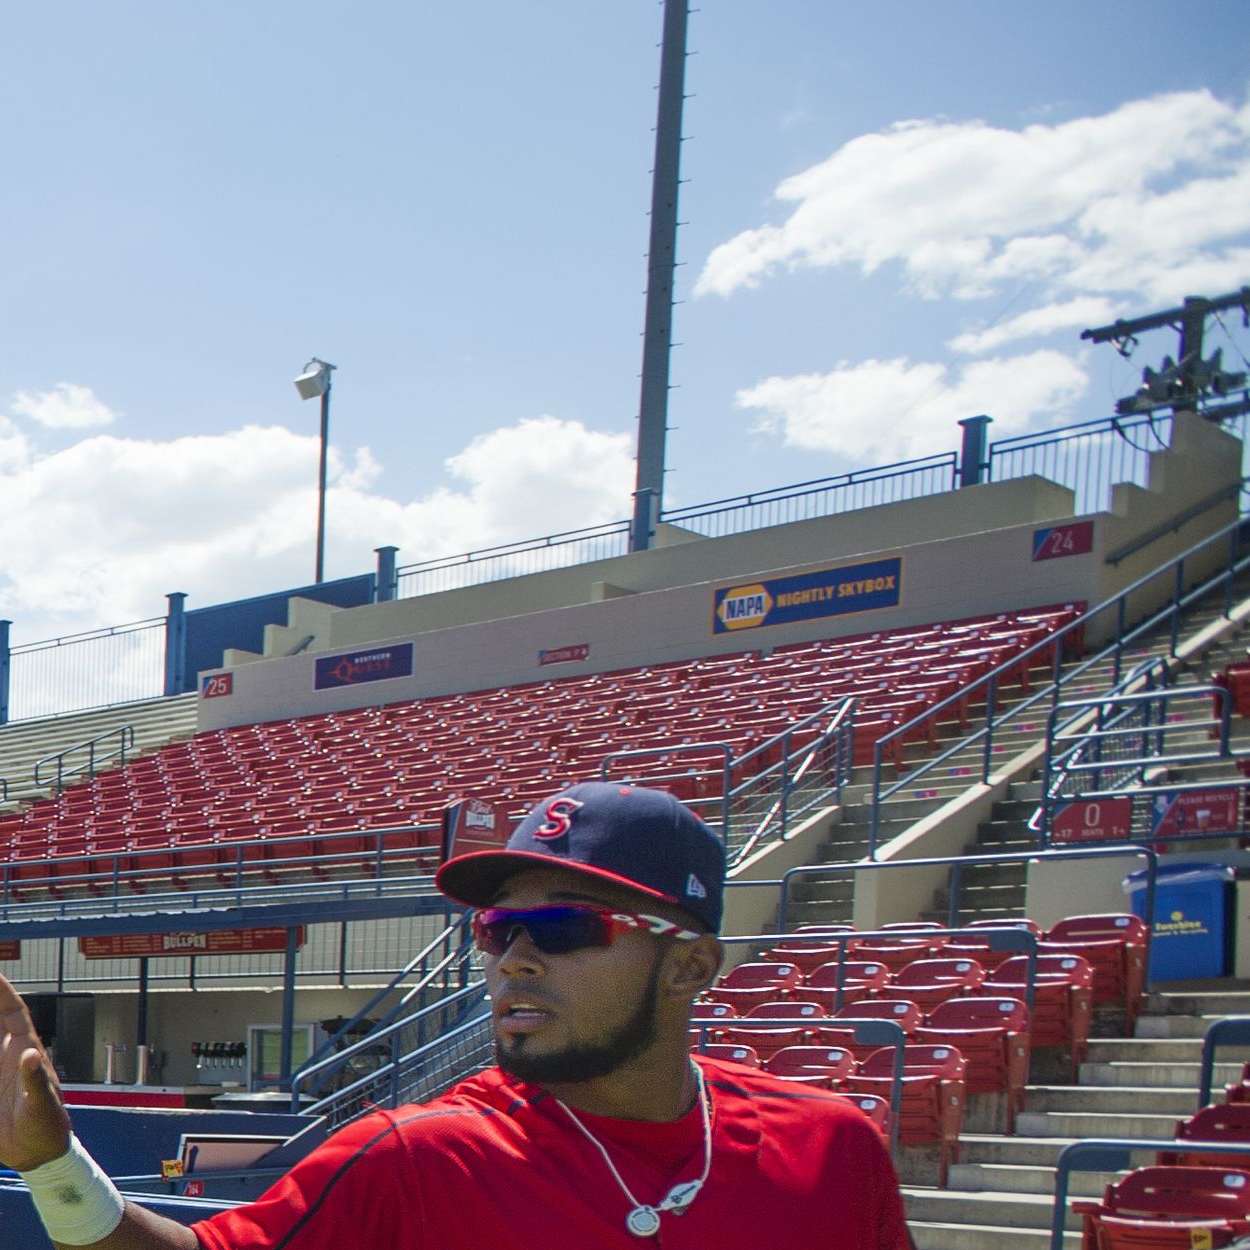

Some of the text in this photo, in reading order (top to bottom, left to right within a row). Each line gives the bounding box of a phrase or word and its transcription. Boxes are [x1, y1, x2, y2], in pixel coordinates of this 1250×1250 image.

[1050, 531, 1074, 554] 24
[725, 575, 896, 622] NAPA NIGHTLY SKYBOX
[209, 677, 227, 695] 25
[533, 797, 584, 840] S
[163, 933, 206, 949] BULLPEN
